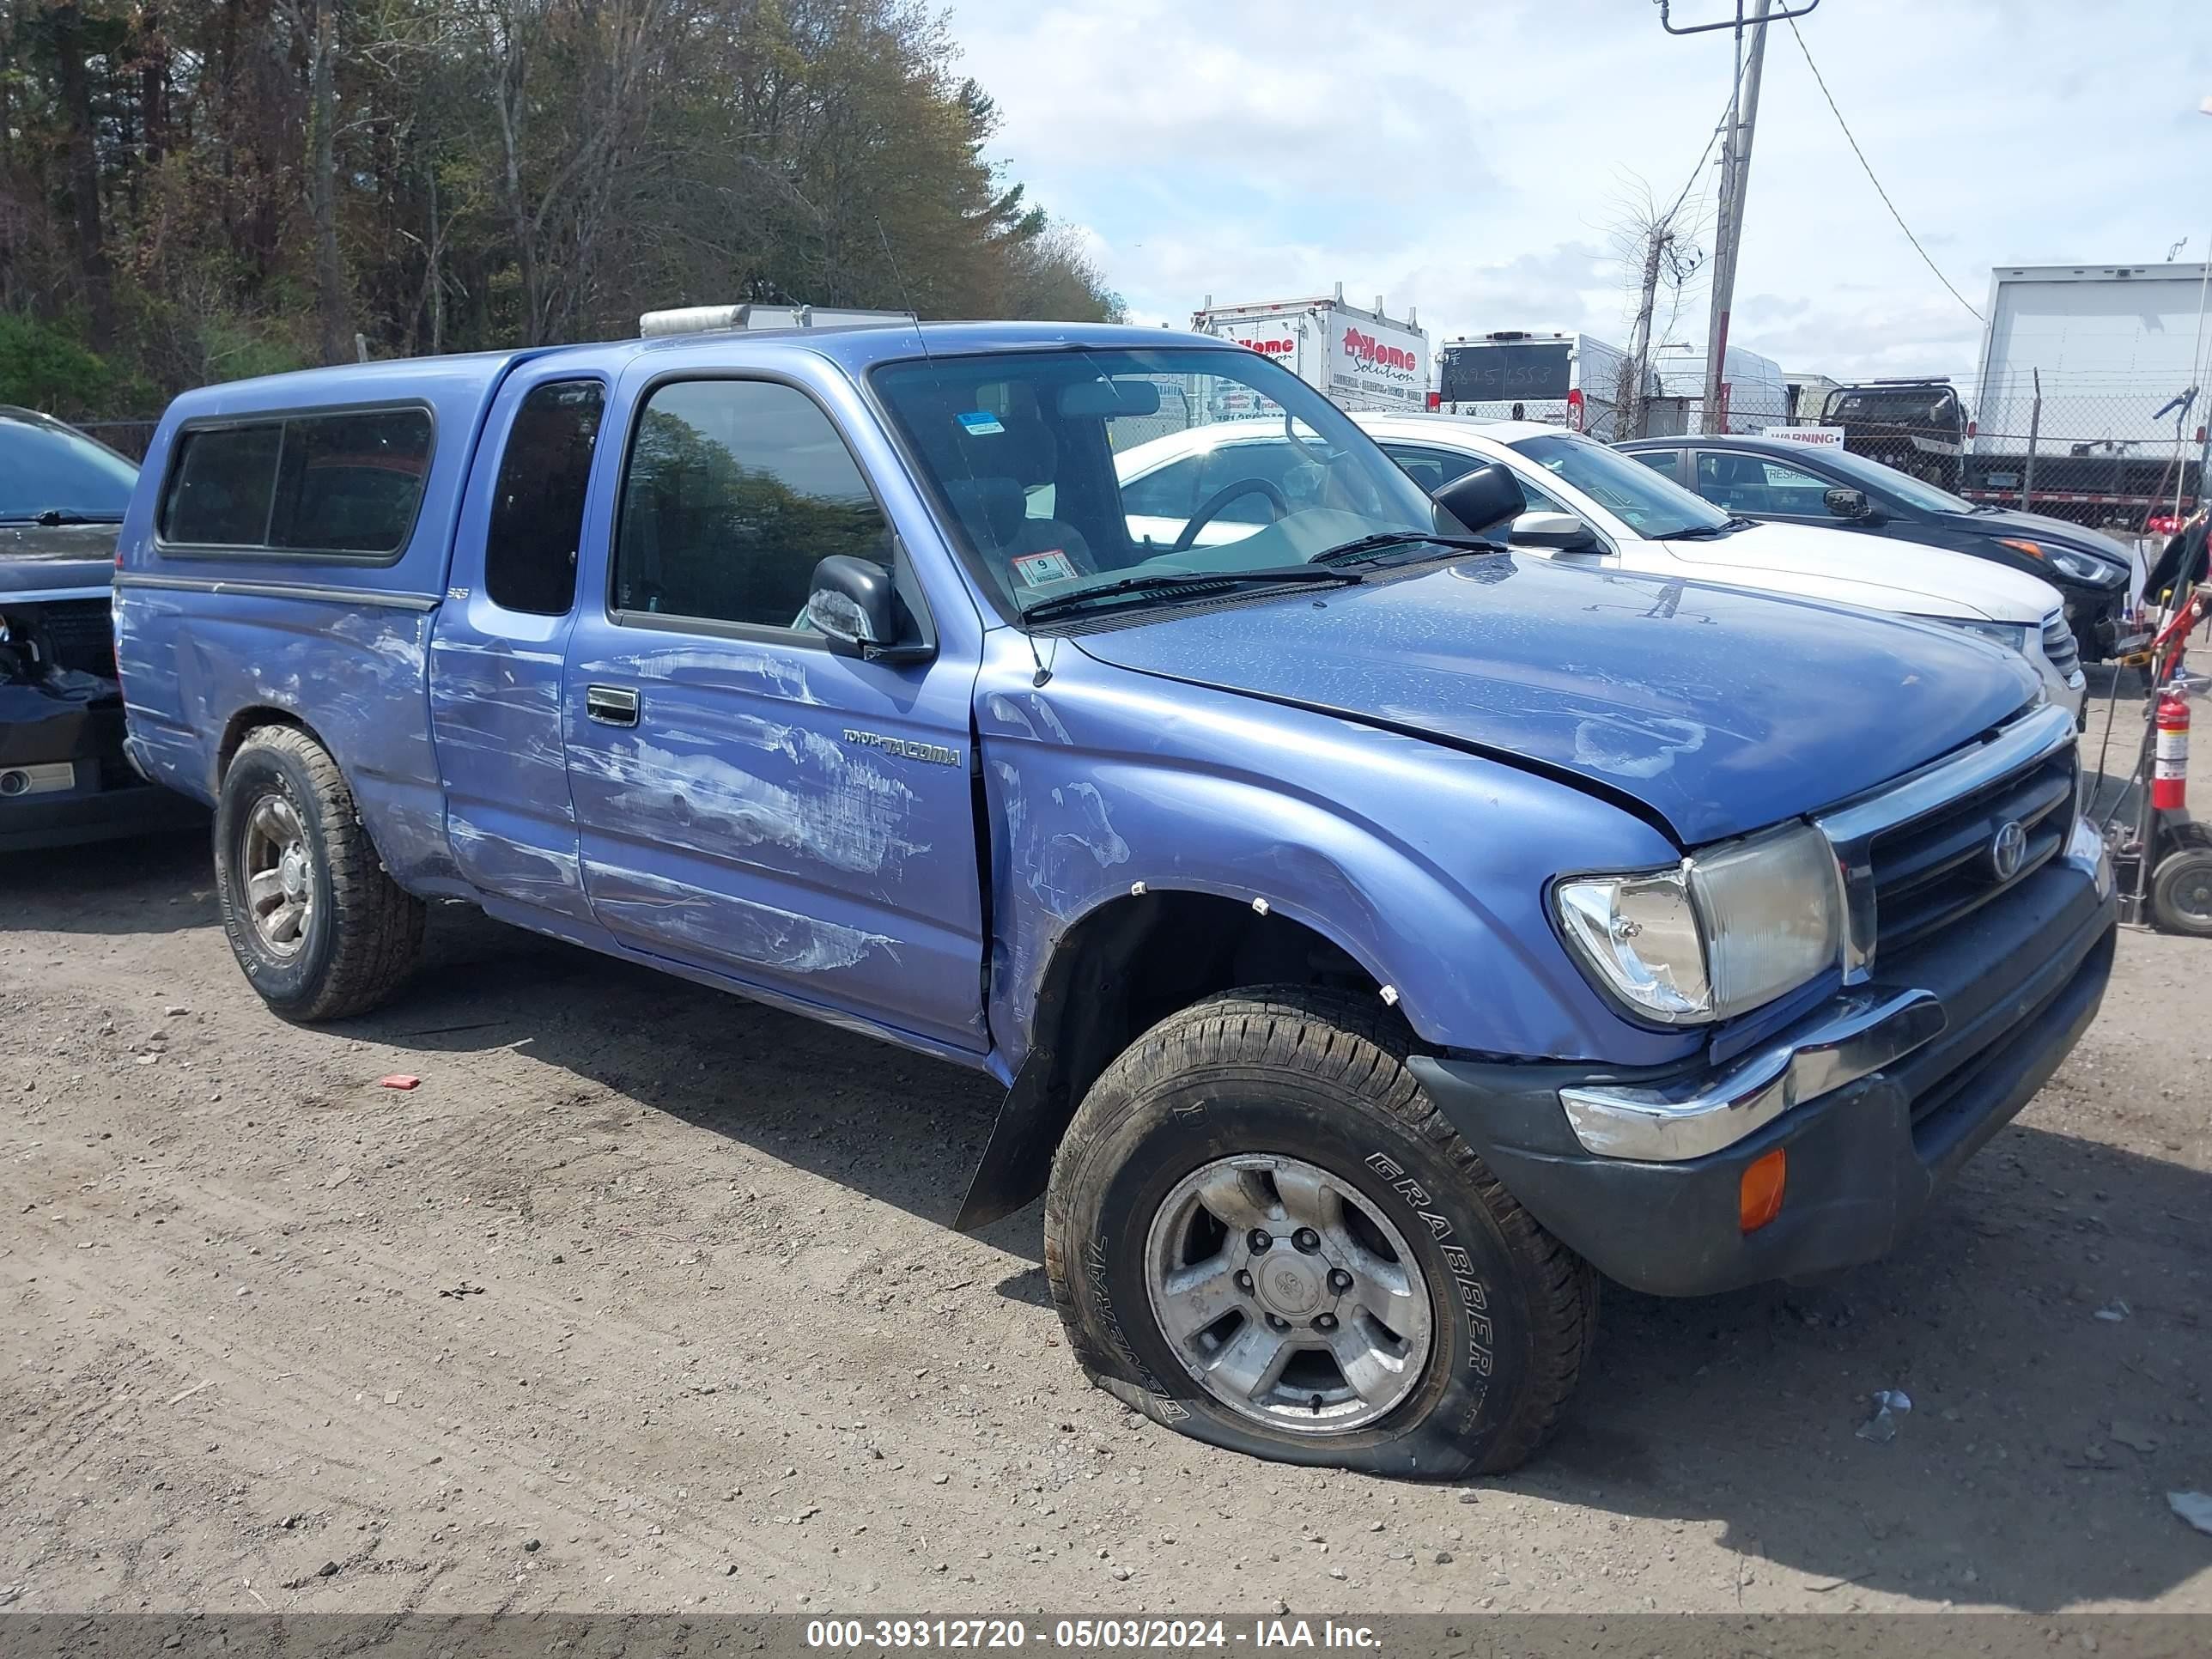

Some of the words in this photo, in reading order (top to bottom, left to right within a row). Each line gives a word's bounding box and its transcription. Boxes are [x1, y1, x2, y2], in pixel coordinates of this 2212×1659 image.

[1352, 354, 1415, 382] Solution
[1361, 335, 1416, 371] Home
[1333, 373, 1359, 389] COMMERCIAL
[1765, 468, 1814, 480] TRESPAS
[1037, 559, 1048, 570] 9
[879, 736, 963, 769] TACOMA
[1364, 1152, 1493, 1378] GRABBER
[1087, 1234, 1191, 1425] GENERAL
